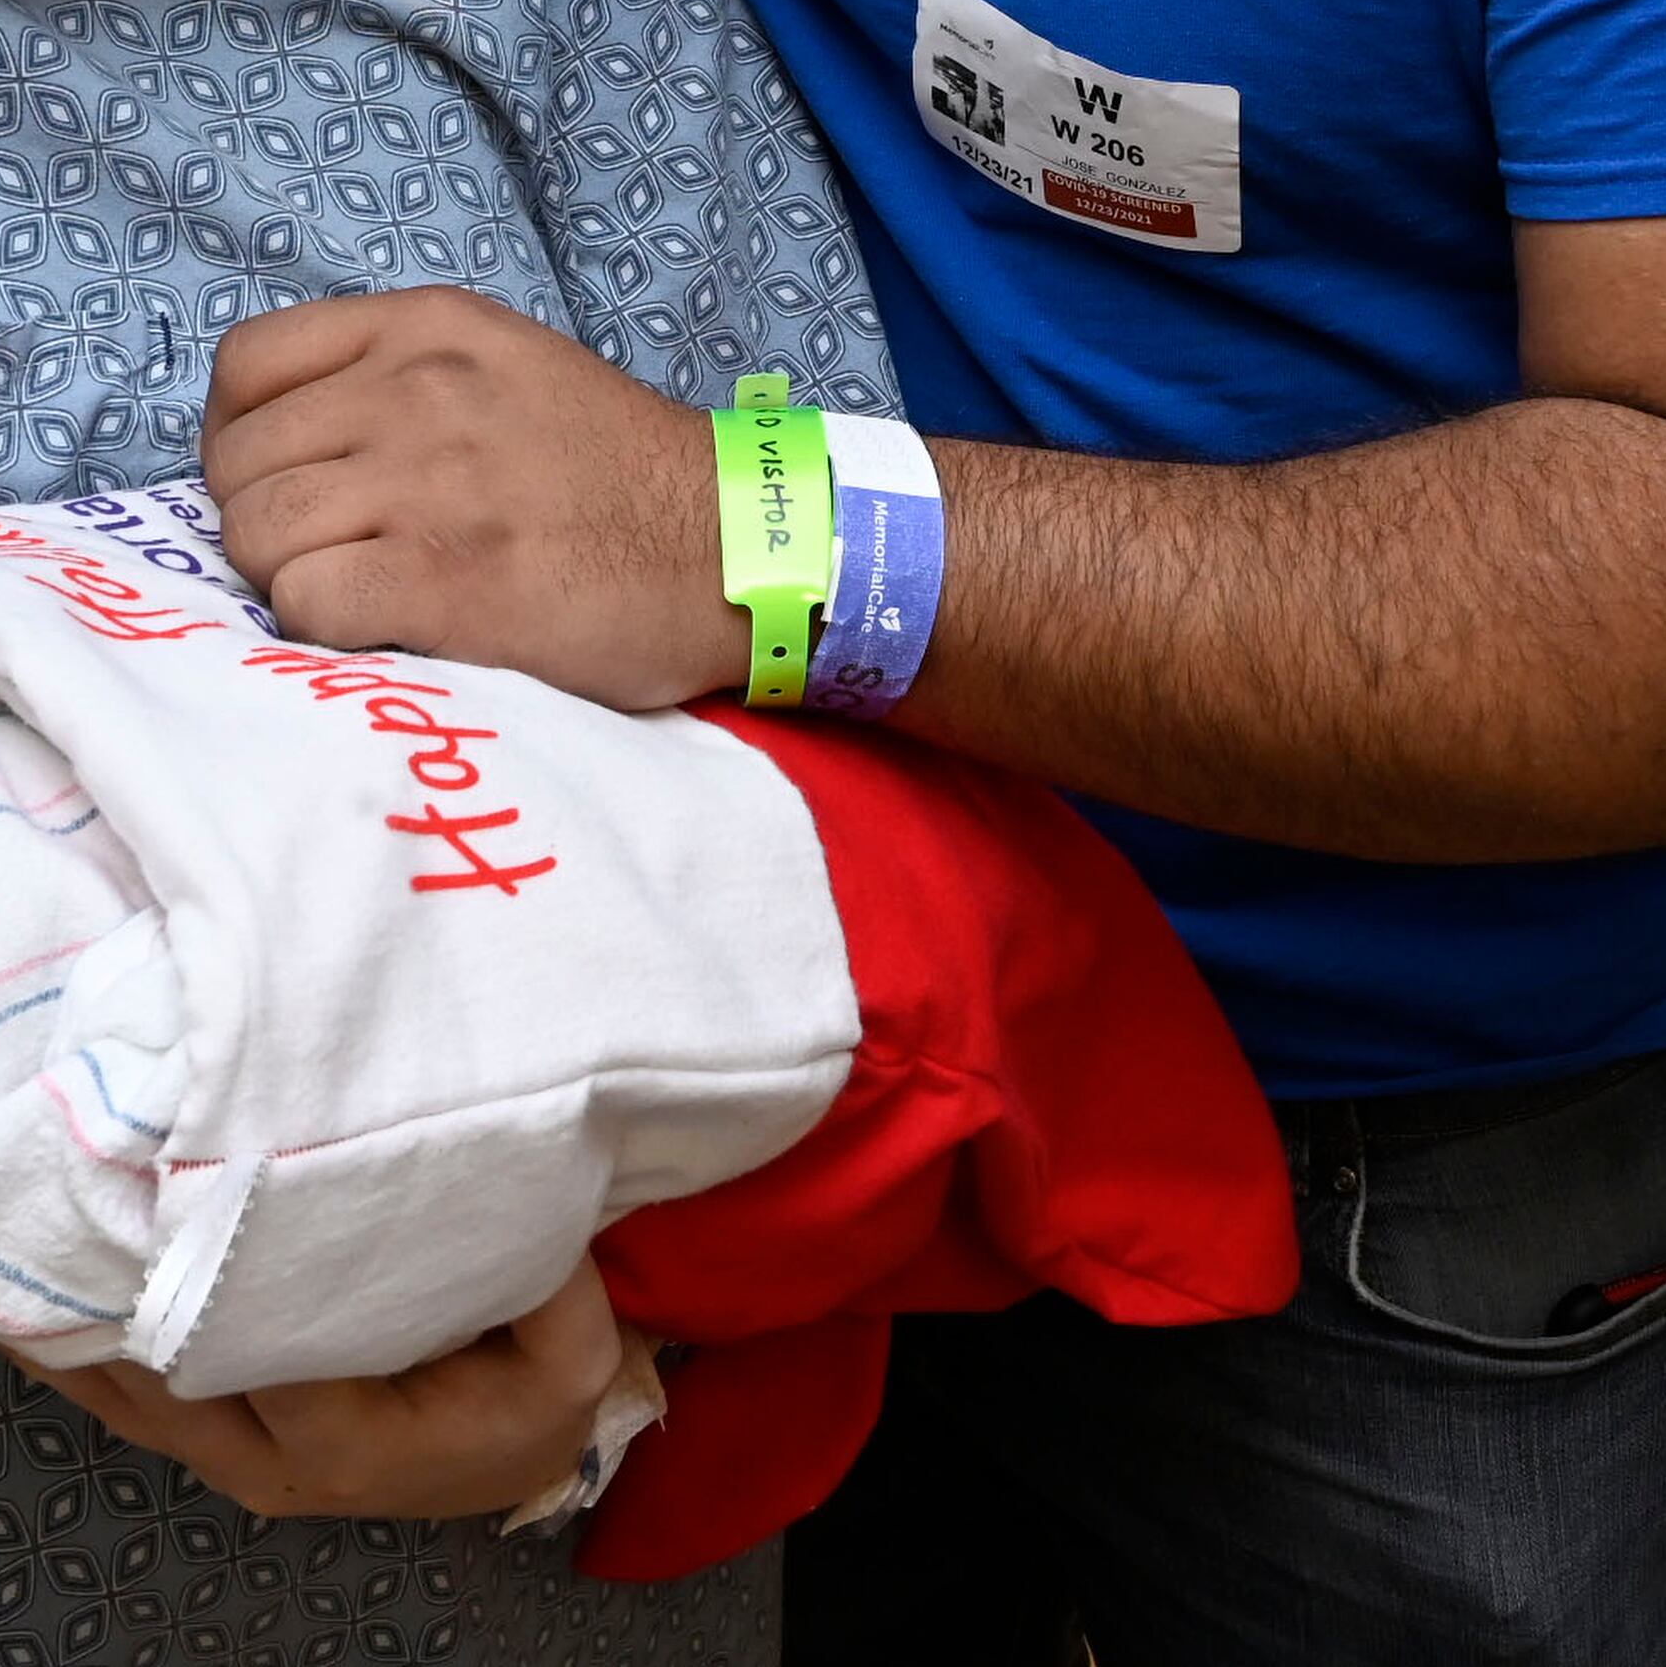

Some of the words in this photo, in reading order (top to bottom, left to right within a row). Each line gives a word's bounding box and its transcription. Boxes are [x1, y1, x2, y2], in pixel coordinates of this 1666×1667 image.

[1074, 76, 1123, 124] W
[951, 135, 1034, 194] 12/23/21
[1051, 114, 1080, 145] W
[1091, 133, 1144, 167] 206
[1047, 172, 1107, 199] COVID-19
[1111, 193, 1182, 214] SCREENED
[1062, 156, 1098, 177] JOSE
[1106, 171, 1186, 198] GONZALEZ
[1075, 197, 1153, 225] 12/23/2021
[860, 499, 890, 633] MemorialCare
[242, 646, 557, 897] Happy
